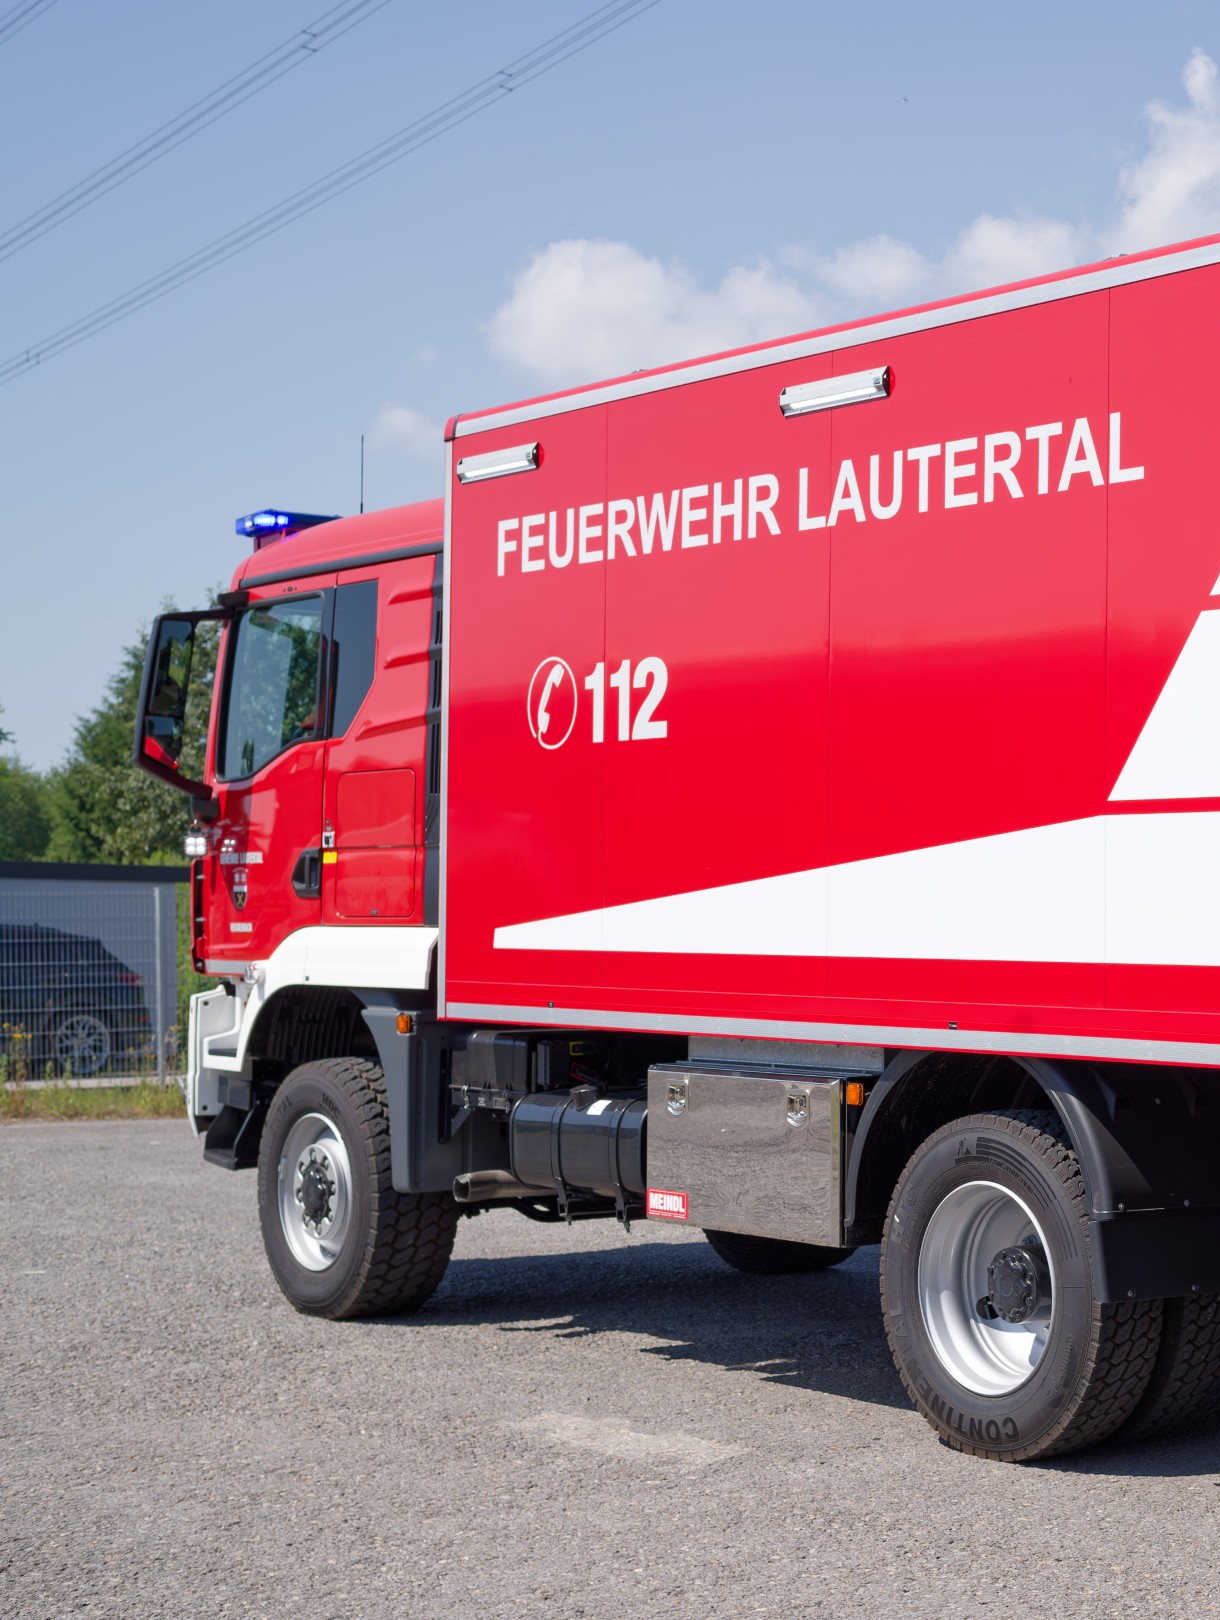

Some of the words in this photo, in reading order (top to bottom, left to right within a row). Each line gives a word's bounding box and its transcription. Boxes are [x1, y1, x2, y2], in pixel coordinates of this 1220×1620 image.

[497, 473, 781, 577] FEUERWEHR
[798, 411, 1145, 531] LAUTERTAL
[584, 656, 668, 743] 112
[650, 1192, 685, 1213] MEINDL
